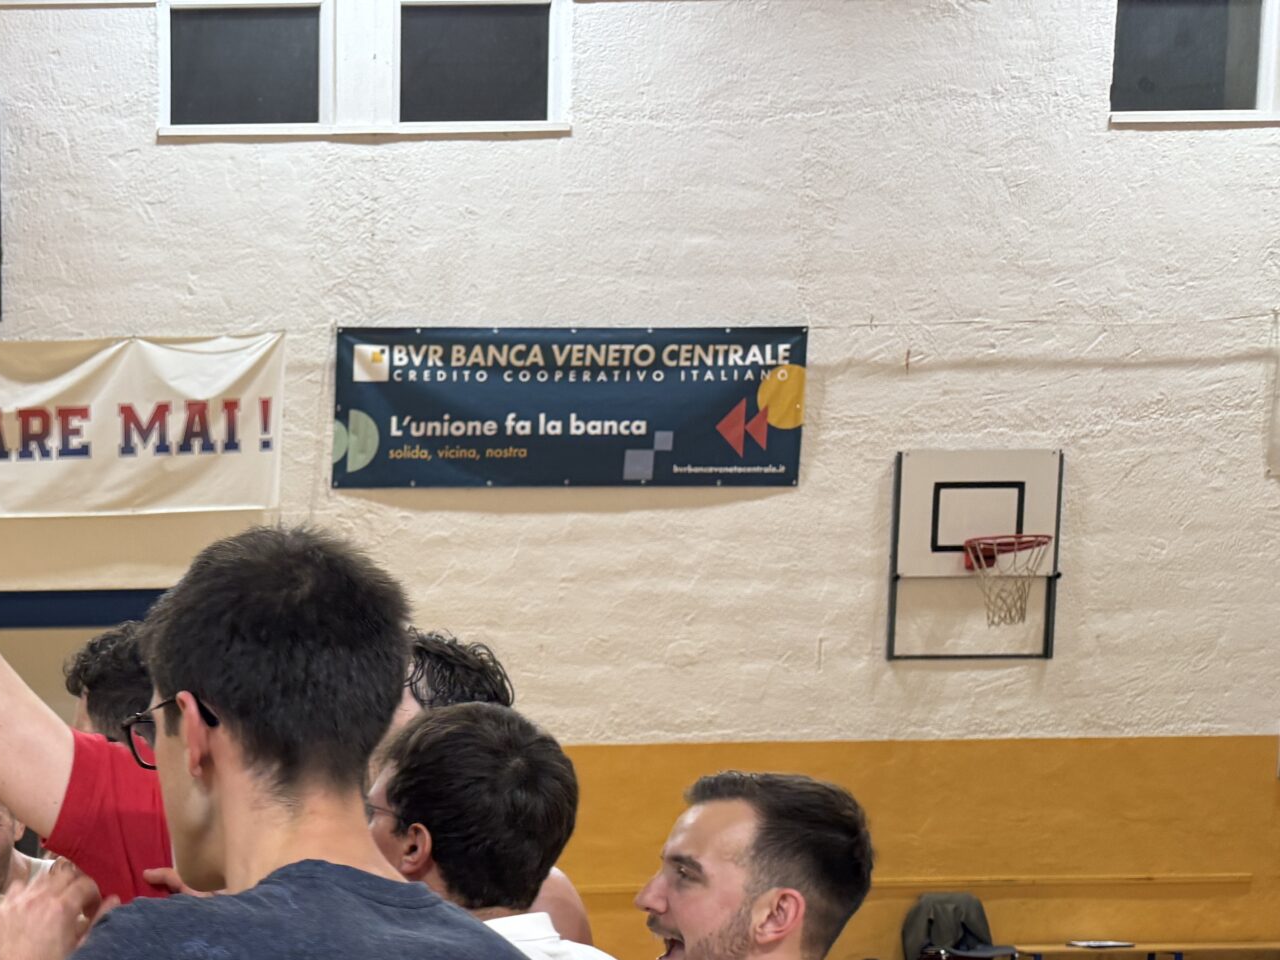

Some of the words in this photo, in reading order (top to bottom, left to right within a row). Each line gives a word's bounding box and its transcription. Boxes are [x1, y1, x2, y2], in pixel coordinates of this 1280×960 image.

[393, 344, 444, 367] BVR
[451, 344, 546, 367] BANCA
[551, 343, 656, 367] VENETO
[663, 343, 790, 367] CENTRALE
[393, 370, 488, 382] CREDITO
[503, 369, 665, 383] COOPERATIVO
[680, 369, 789, 382] ITALIANO
[390, 414, 500, 437] L'unione
[504, 413, 533, 436] fa
[538, 414, 564, 436] la
[569, 413, 647, 436] banca
[388, 445, 432, 460] solida,
[437, 446, 481, 461] vicina,
[485, 446, 527, 459] nostra
